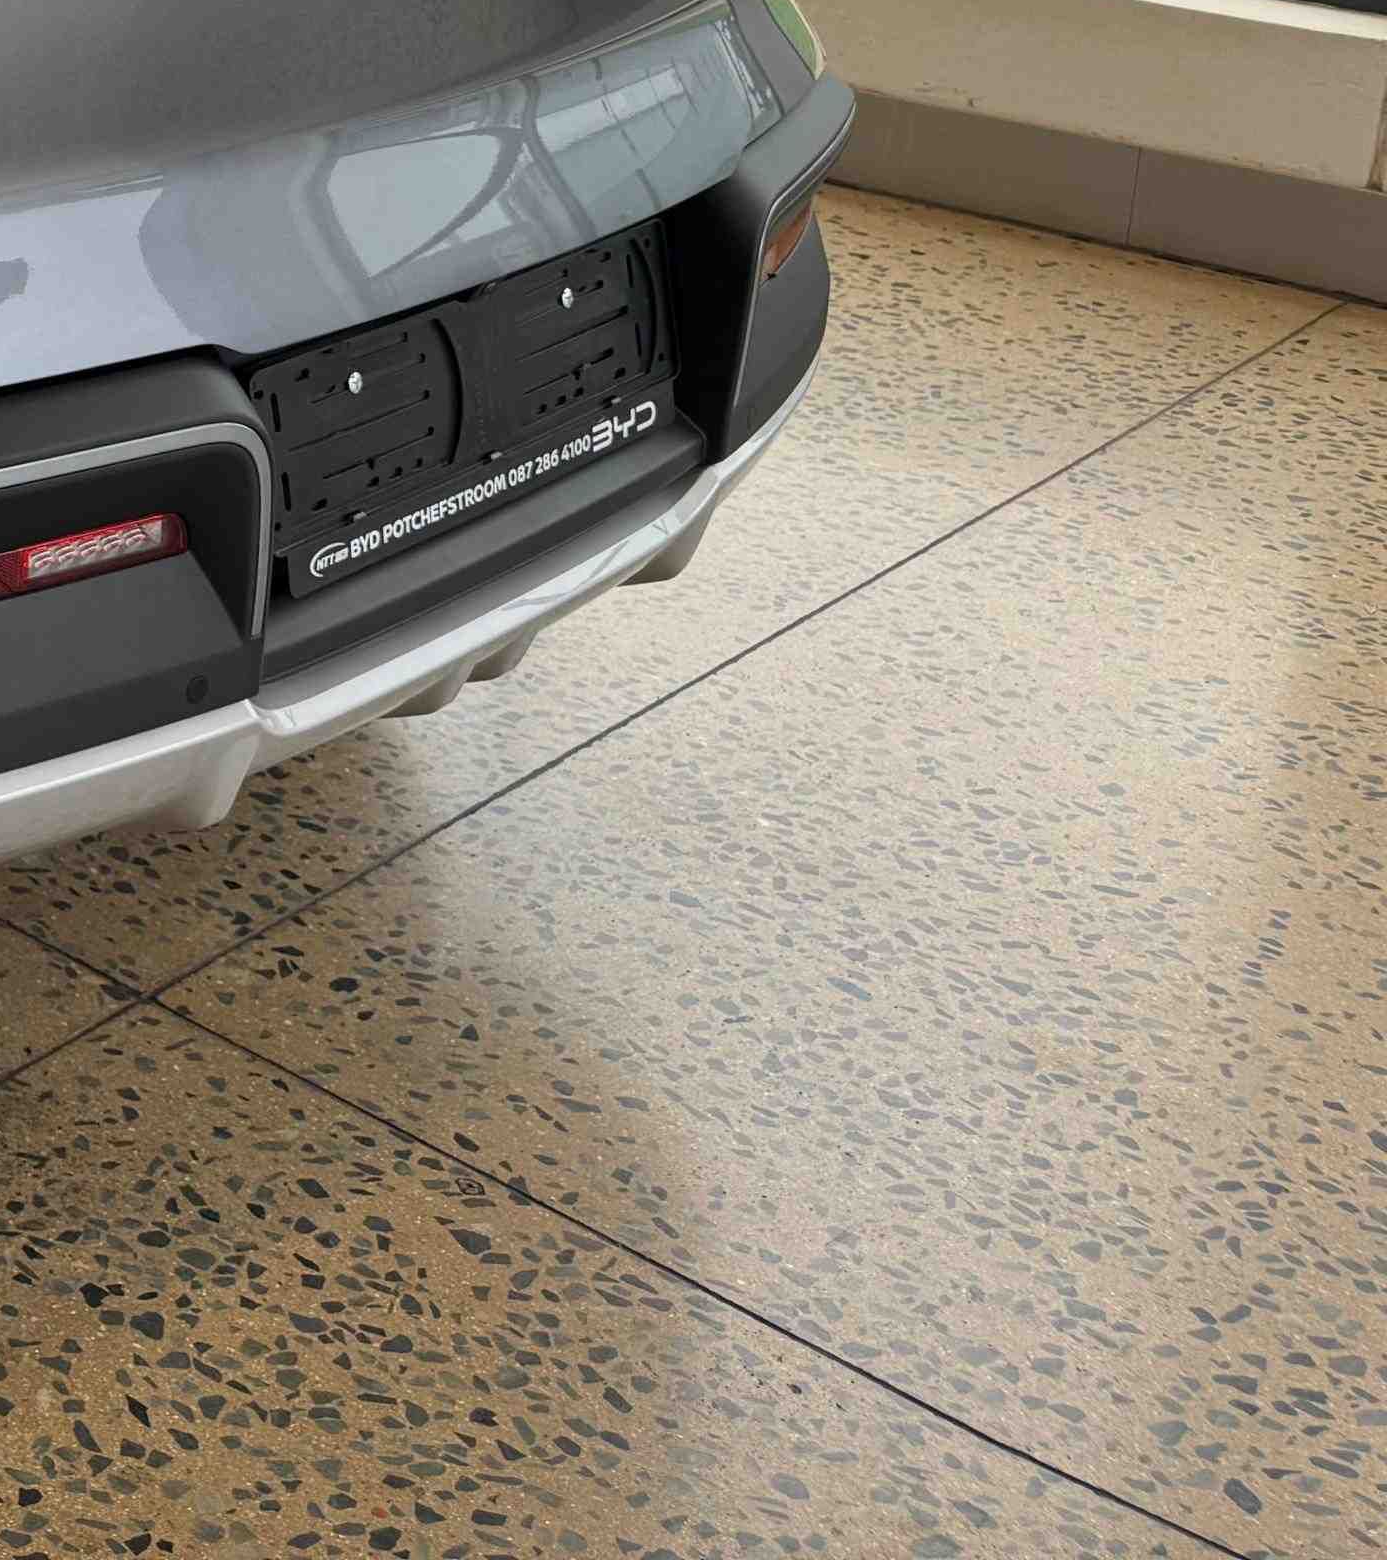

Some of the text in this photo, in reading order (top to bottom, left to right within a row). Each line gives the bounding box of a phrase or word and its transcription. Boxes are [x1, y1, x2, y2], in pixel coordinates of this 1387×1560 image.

[350, 530, 380, 558] BYD
[382, 474, 507, 544] POTCHEFSTROOM
[508, 461, 533, 487] 087
[535, 448, 559, 475] 286
[561, 434, 591, 460] 4100
[592, 401, 656, 452] BYD
